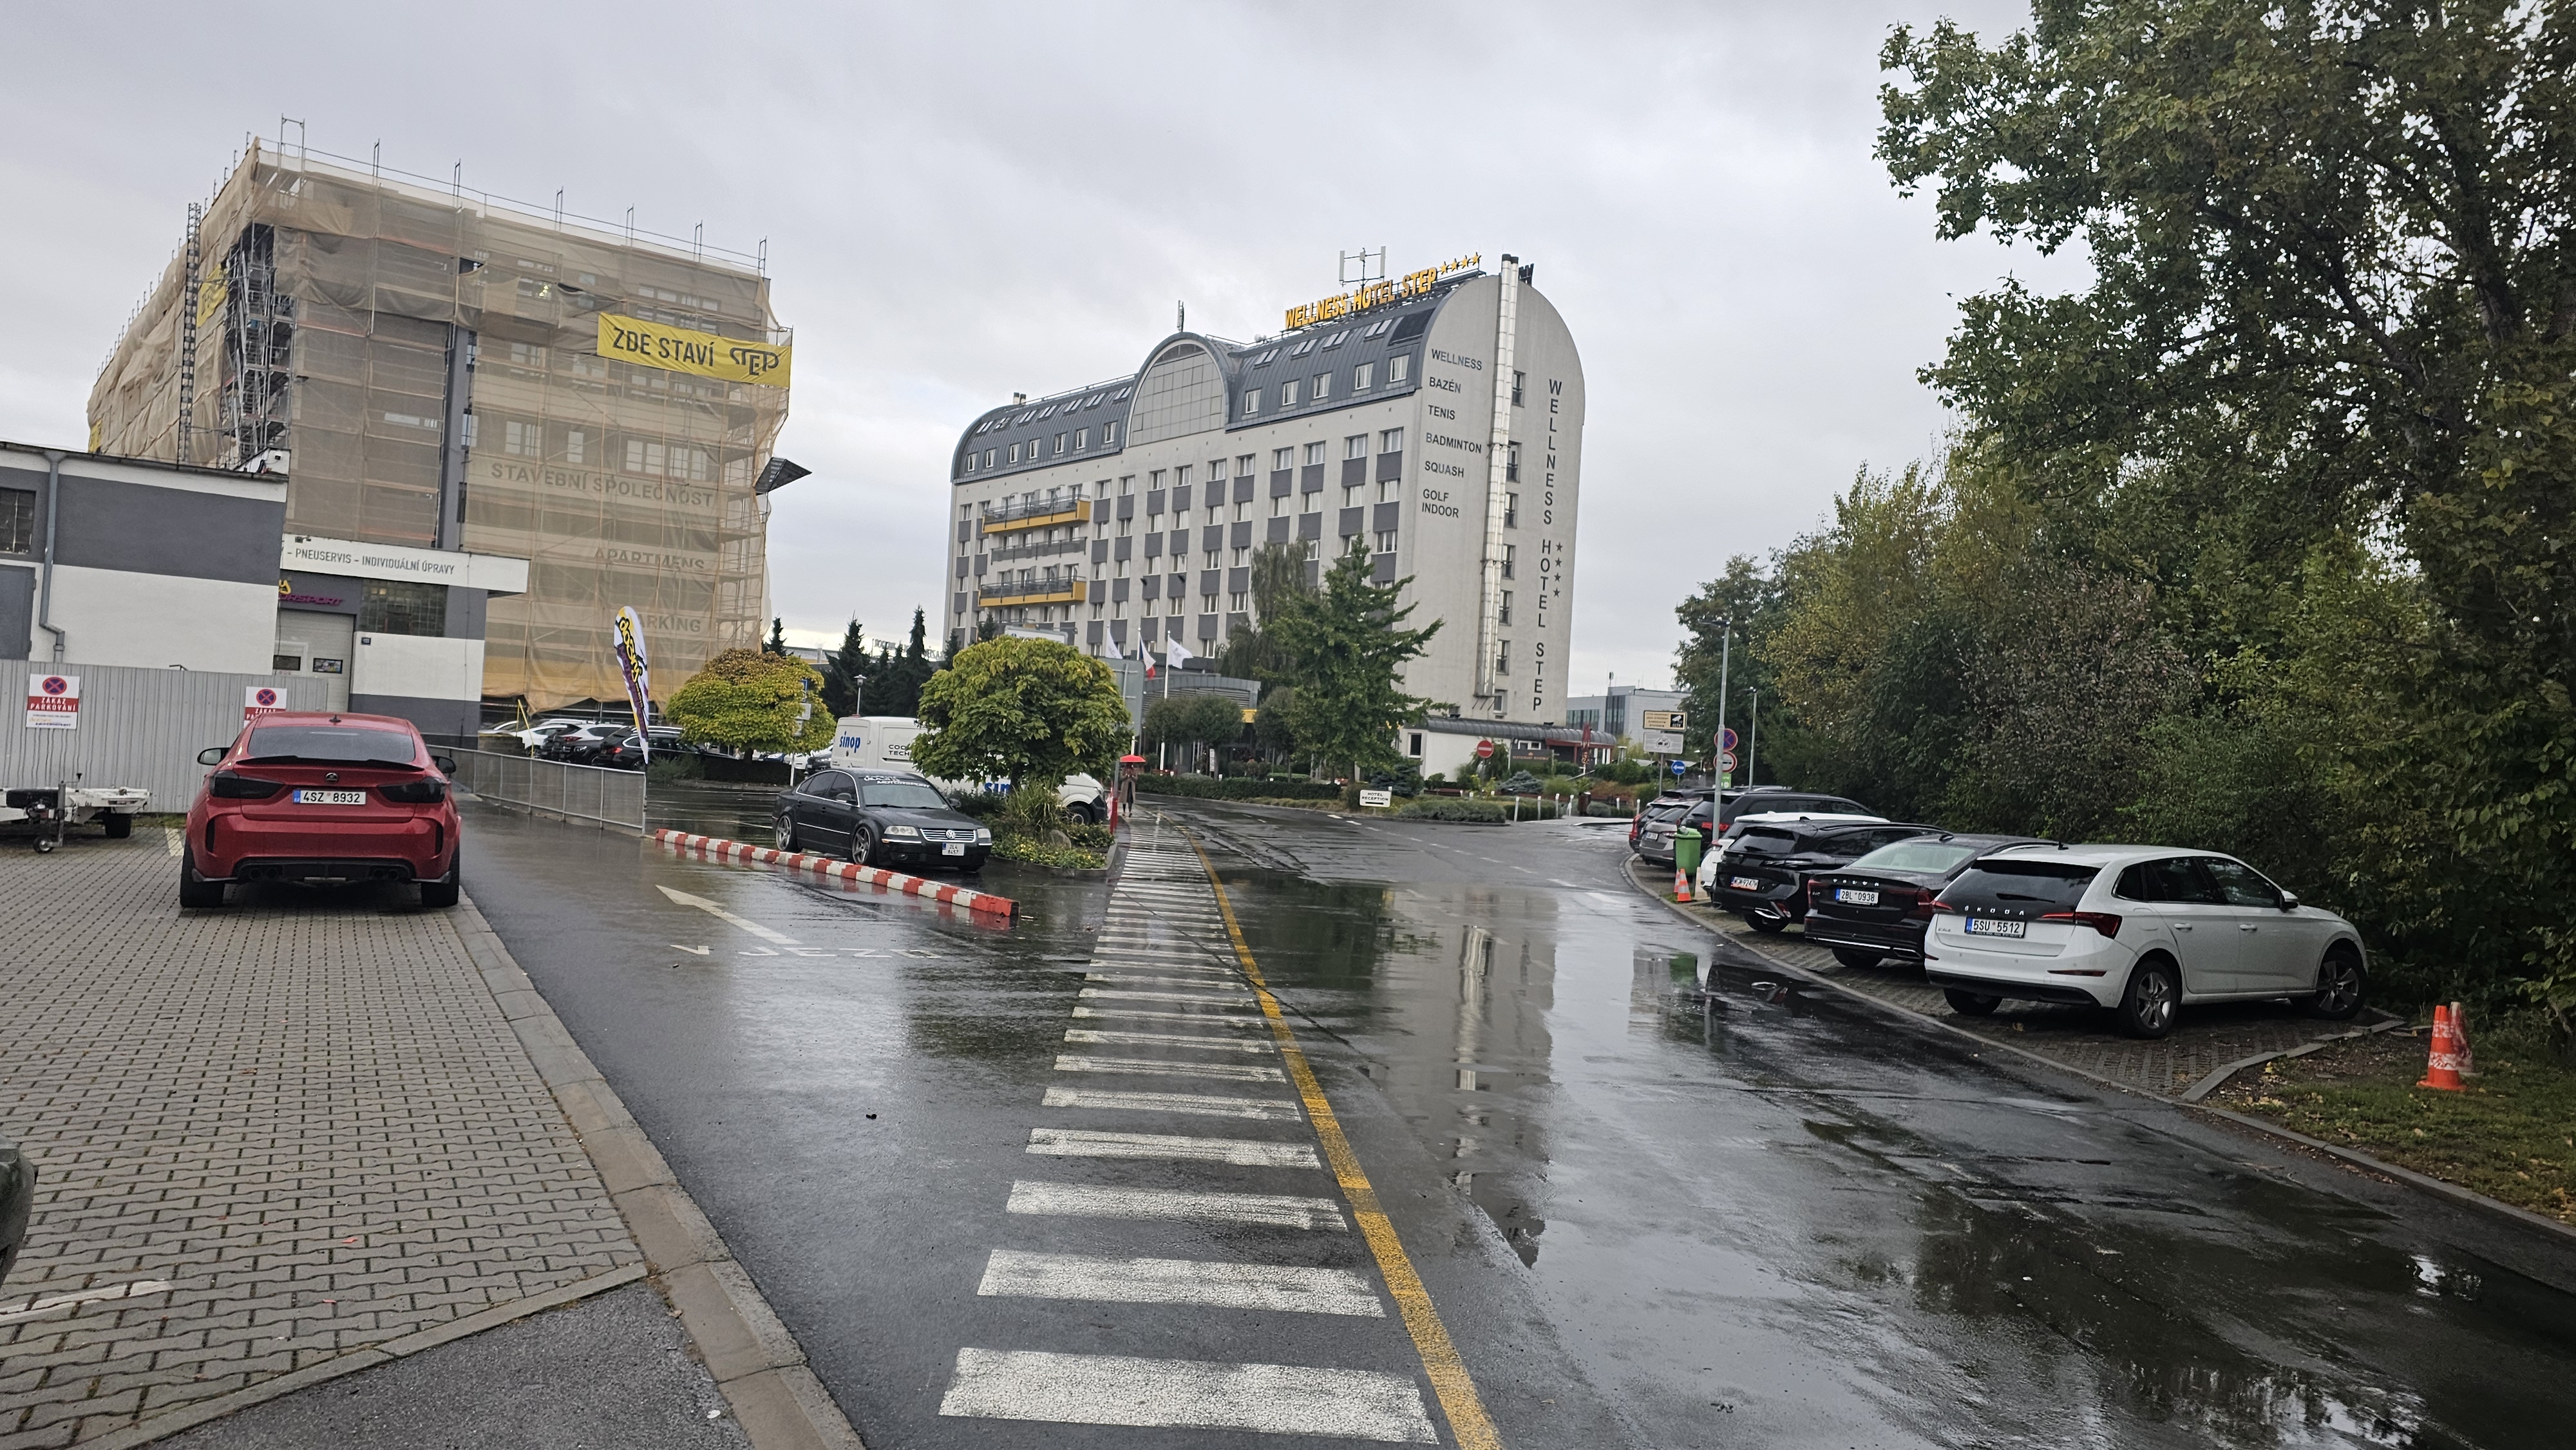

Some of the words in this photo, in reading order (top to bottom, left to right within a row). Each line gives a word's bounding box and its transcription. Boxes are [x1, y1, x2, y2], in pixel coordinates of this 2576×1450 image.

[1285, 293, 1348, 330] WELLNESS
[1353, 279, 1396, 312] HOTEL
[1401, 267, 1438, 297] STEP
[612, 327, 650, 355] ZDE
[658, 337, 714, 367] STAVÍ
[730, 347, 779, 375] STEP
[1432, 348, 1482, 371] WELLNESS
[1429, 377, 1461, 394] BAZÉN
[1428, 405, 1455, 420] TENIS
[1426, 432, 1482, 454] BADMINTON
[1543, 379, 1562, 525] WELLNESS
[491, 463, 587, 490] STAVEBNÍ
[1425, 461, 1464, 478] SQUASH
[1423, 489, 1449, 502] GOLF
[1422, 502, 1459, 518] INDOOR
[296, 549, 352, 563] PNEUSERVIS
[362, 556, 420, 571] INDIVIDUÁLNÍ
[422, 560, 455, 575] ÚPRAVY
[1538, 539, 1551, 628] HOTEL
[638, 614, 701, 632] ARKING
[1533, 643, 1544, 711] STEP
[30, 702, 76, 711] PARKOVÁNÍ
[839, 731, 860, 753] sinop
[303, 792, 324, 802] 4SZ
[333, 793, 360, 803] 8932
[1842, 891, 1852, 899] 2BL
[1858, 892, 1875, 901] 0938
[1973, 920, 1990, 931] 5SU
[1997, 922, 2020, 934] 5512
